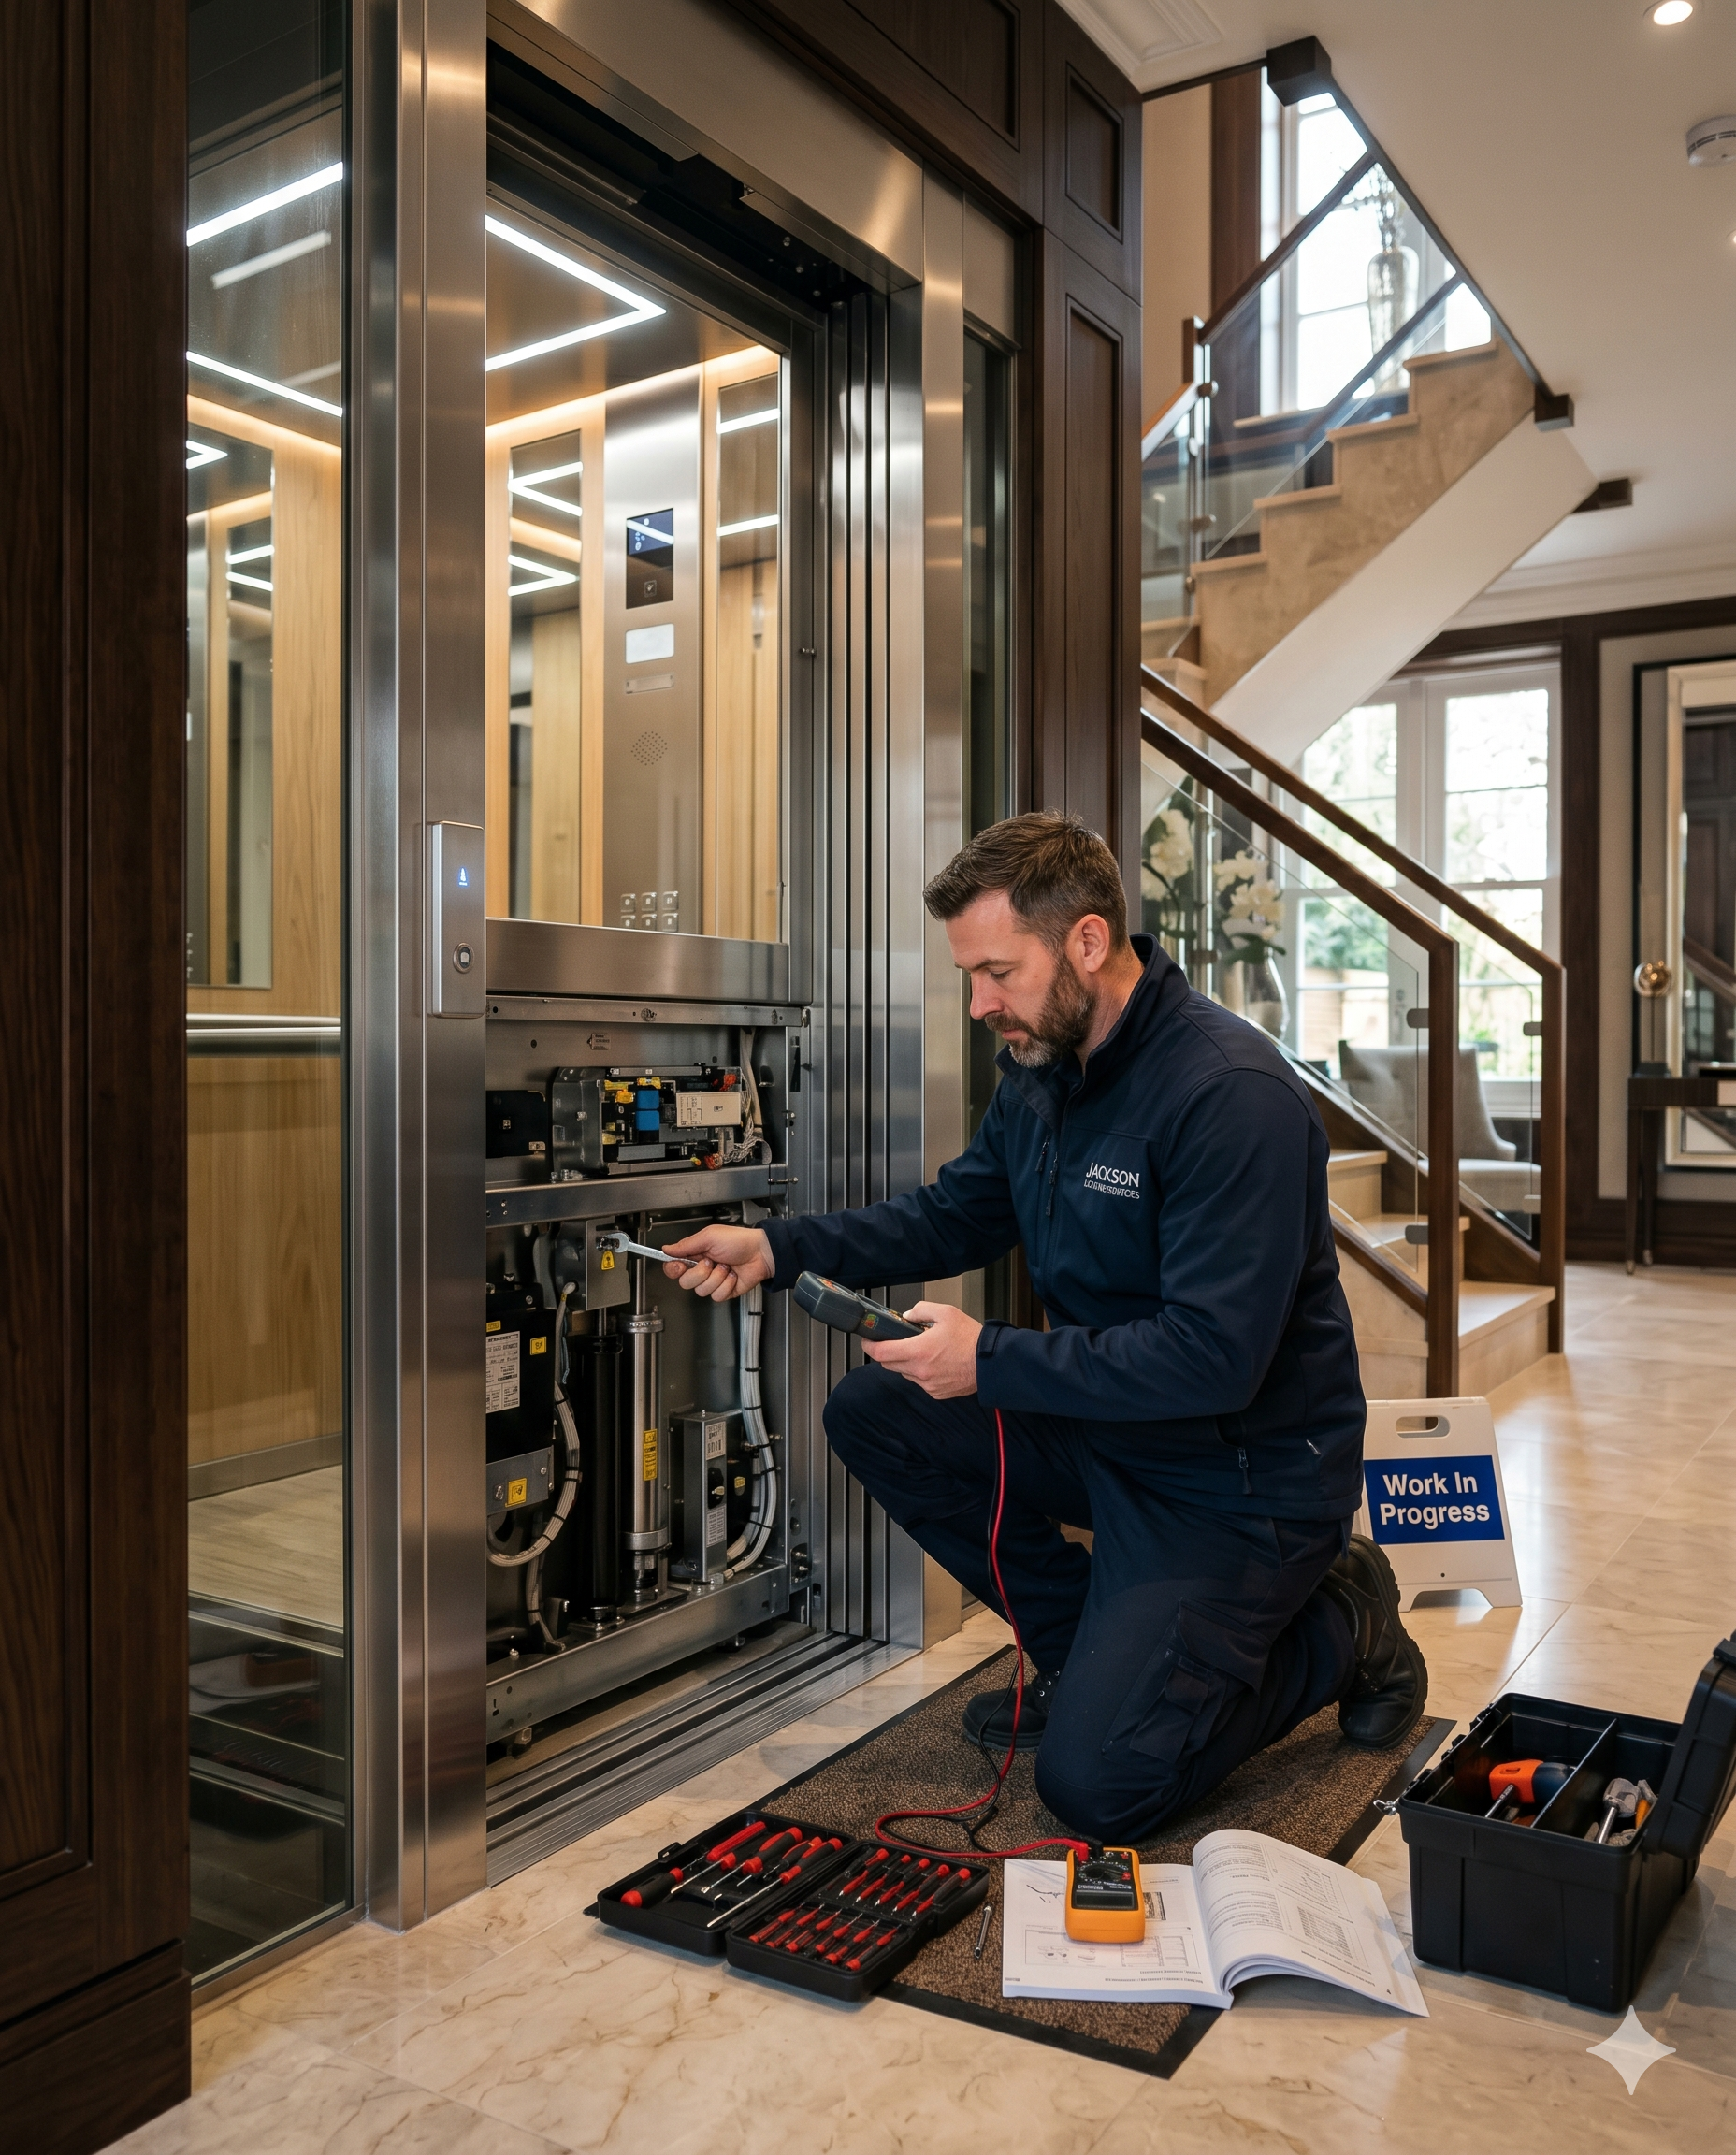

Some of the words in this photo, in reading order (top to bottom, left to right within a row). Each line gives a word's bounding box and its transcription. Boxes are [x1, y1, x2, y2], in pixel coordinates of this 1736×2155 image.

[1086, 1162, 1140, 1188] JACKSON
[1382, 1472, 1449, 1497] Work
[1454, 1471, 1478, 1494] In
[1380, 1503, 1490, 1530] Progress
